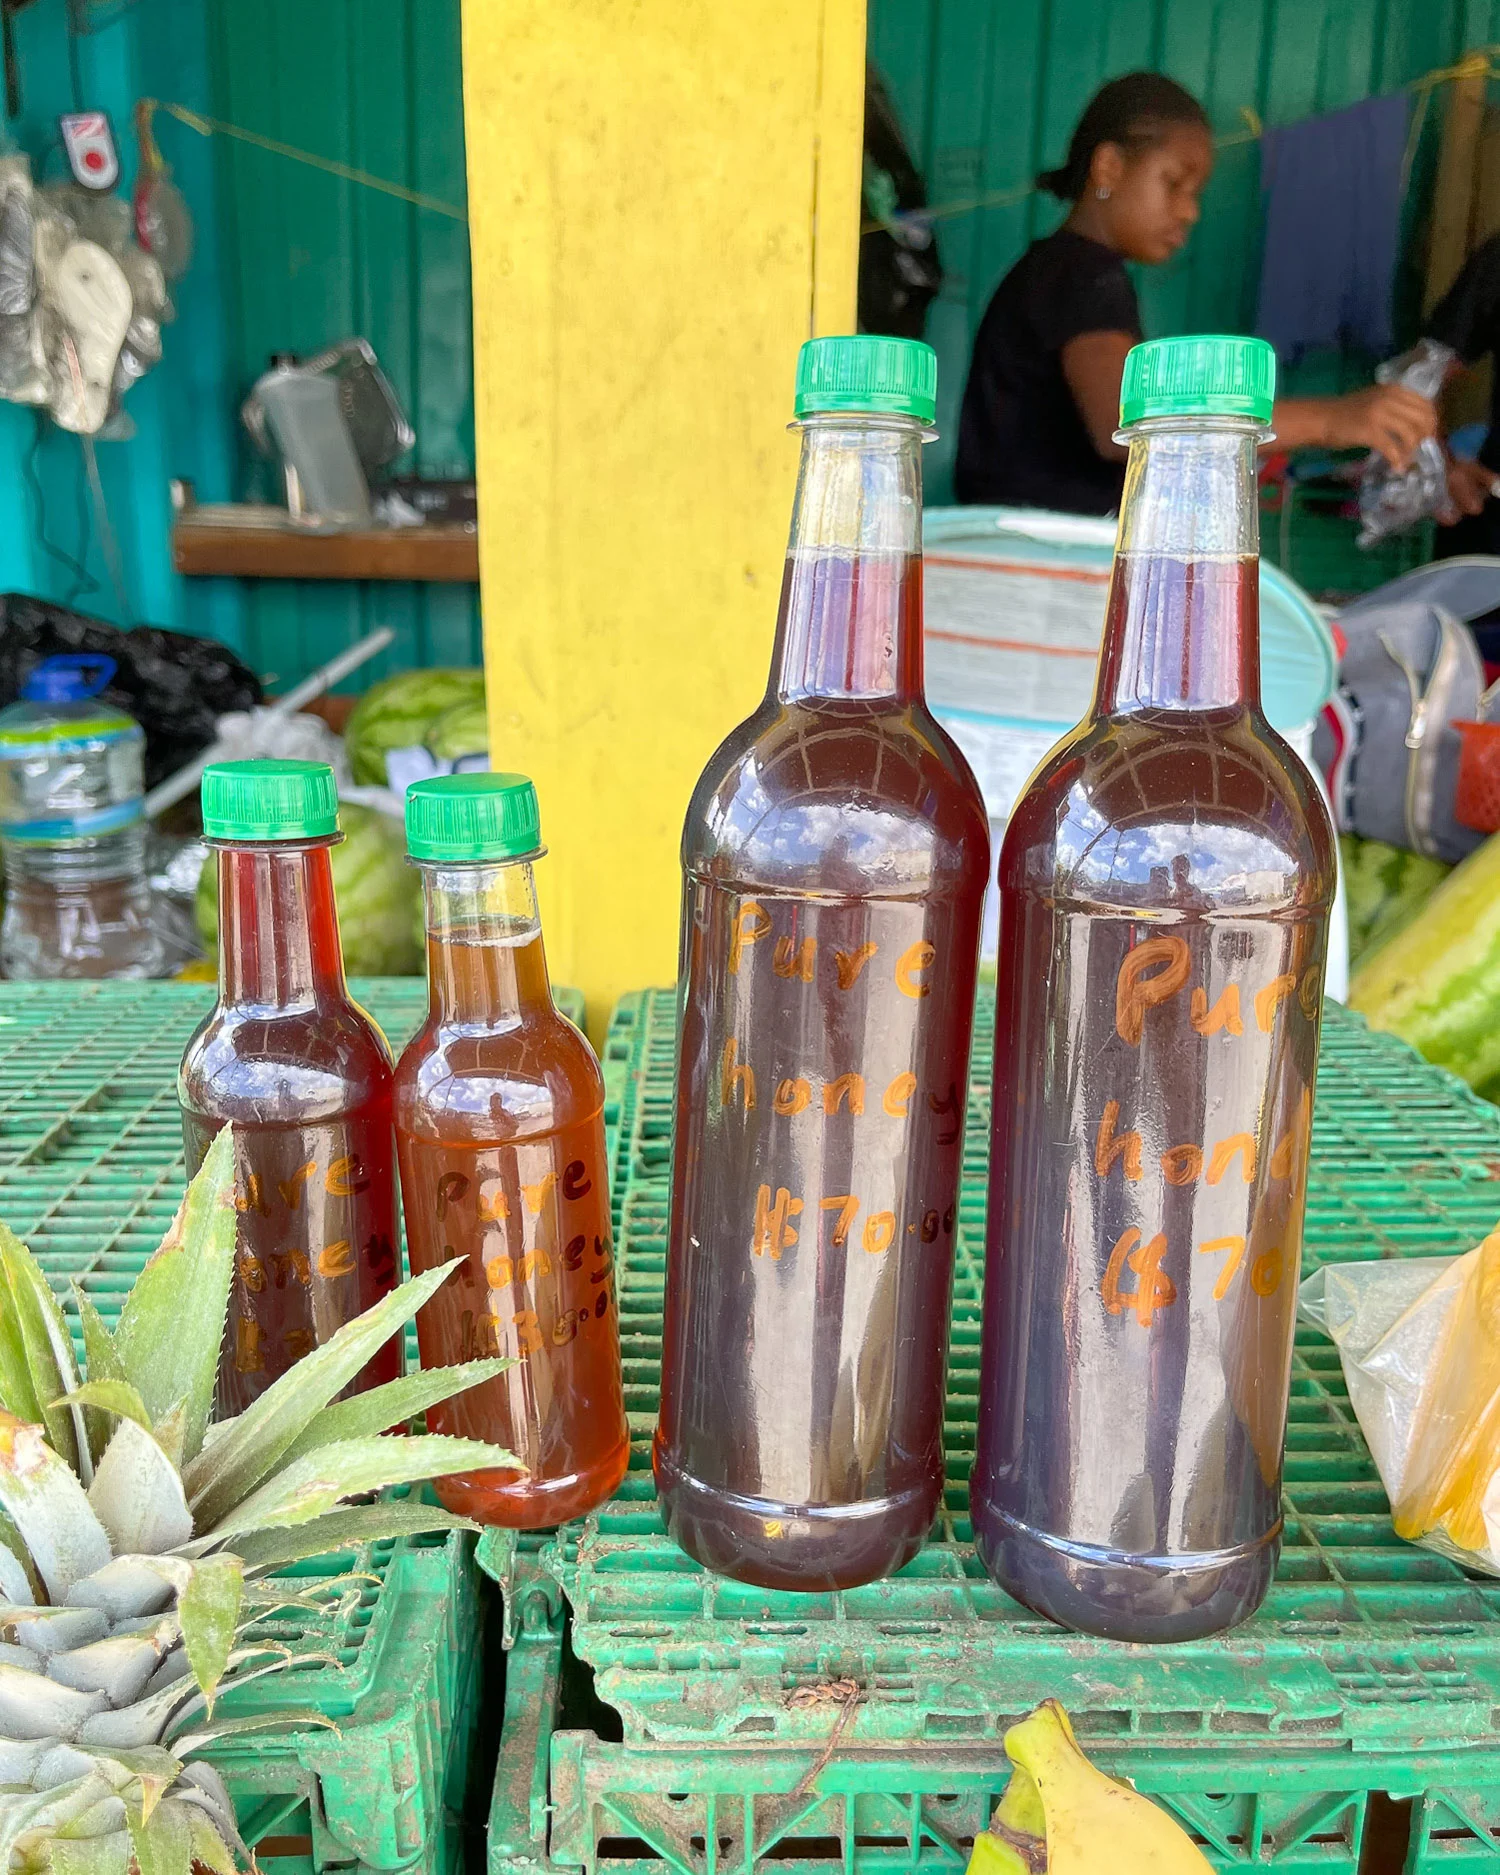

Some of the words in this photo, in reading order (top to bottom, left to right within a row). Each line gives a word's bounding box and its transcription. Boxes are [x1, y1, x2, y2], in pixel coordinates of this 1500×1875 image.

[728, 902, 936, 998] Pure
[1116, 935, 1321, 1047] Pure
[721, 1037, 961, 1146] honey
[235, 1153, 371, 1218] ure
[436, 1160, 592, 1222] Pure
[238, 1234, 395, 1293] oney
[444, 1234, 614, 1289] honey
